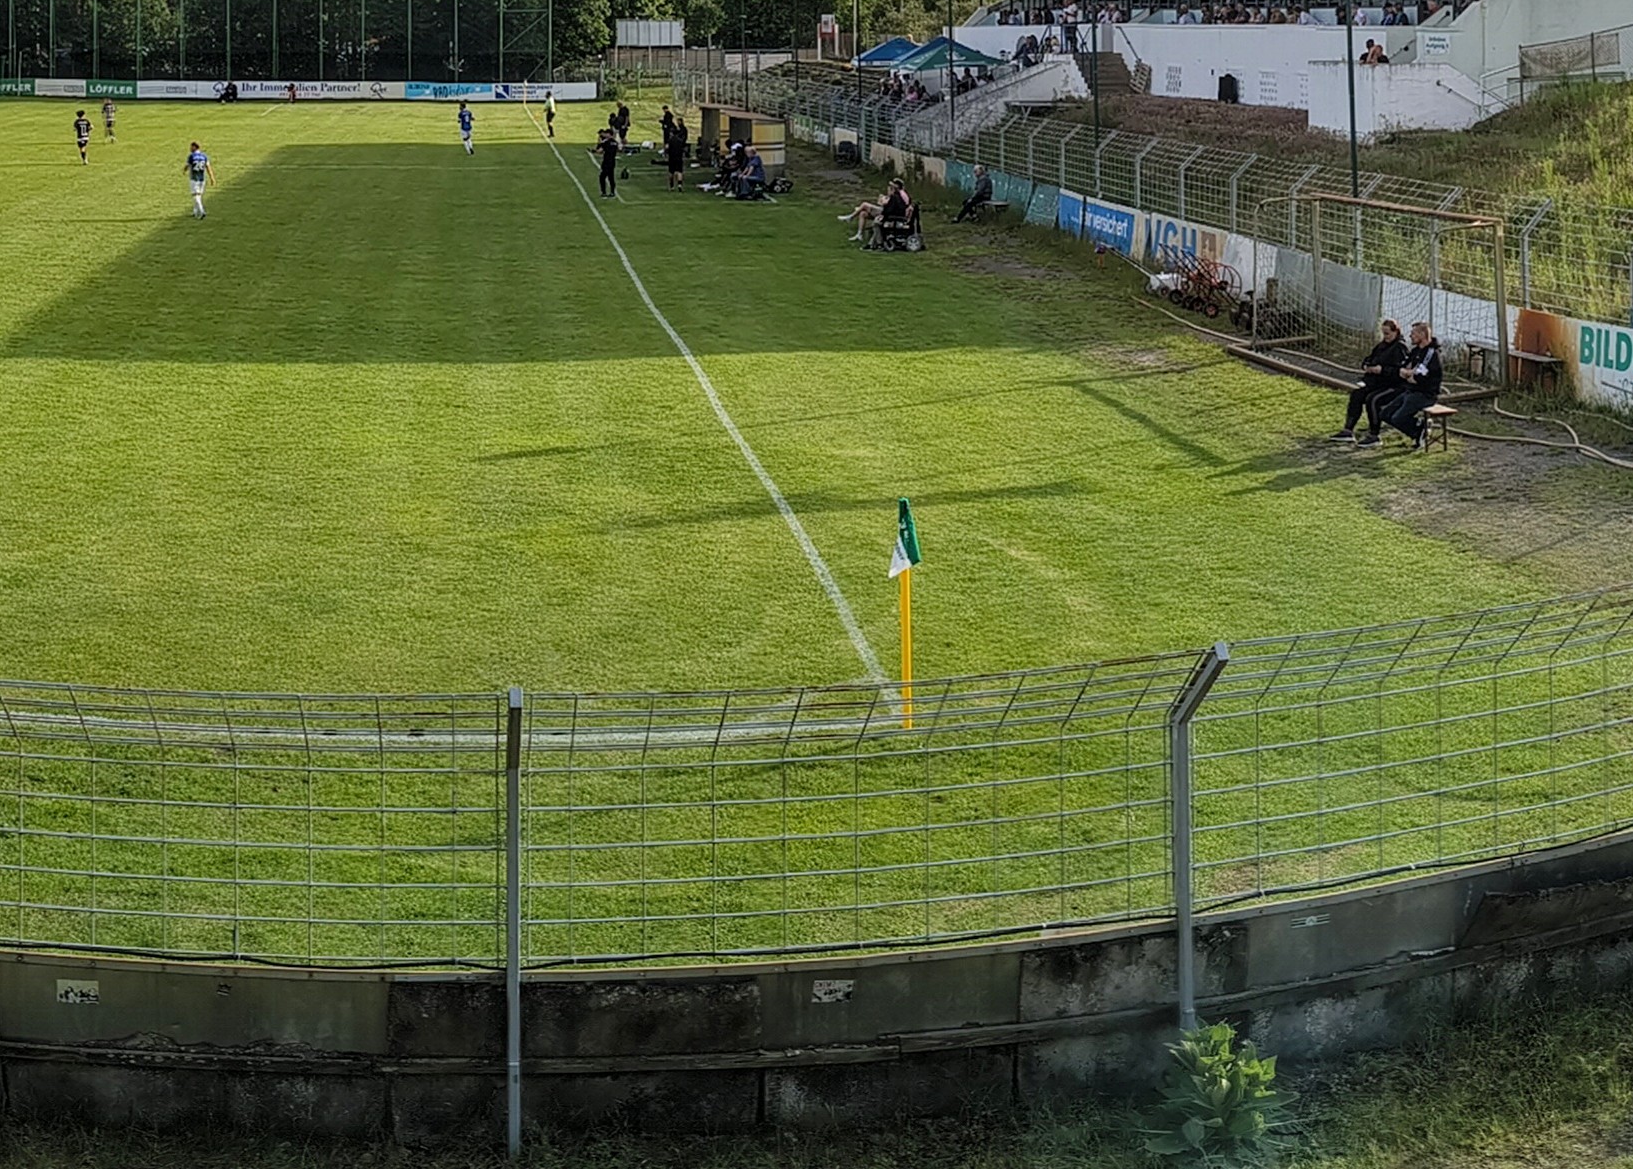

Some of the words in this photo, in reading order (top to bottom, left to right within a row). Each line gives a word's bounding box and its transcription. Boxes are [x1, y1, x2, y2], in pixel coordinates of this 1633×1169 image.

[89, 83, 134, 95] LÖFFLER
[241, 82, 257, 92] Ihr
[320, 82, 361, 93] Partner!
